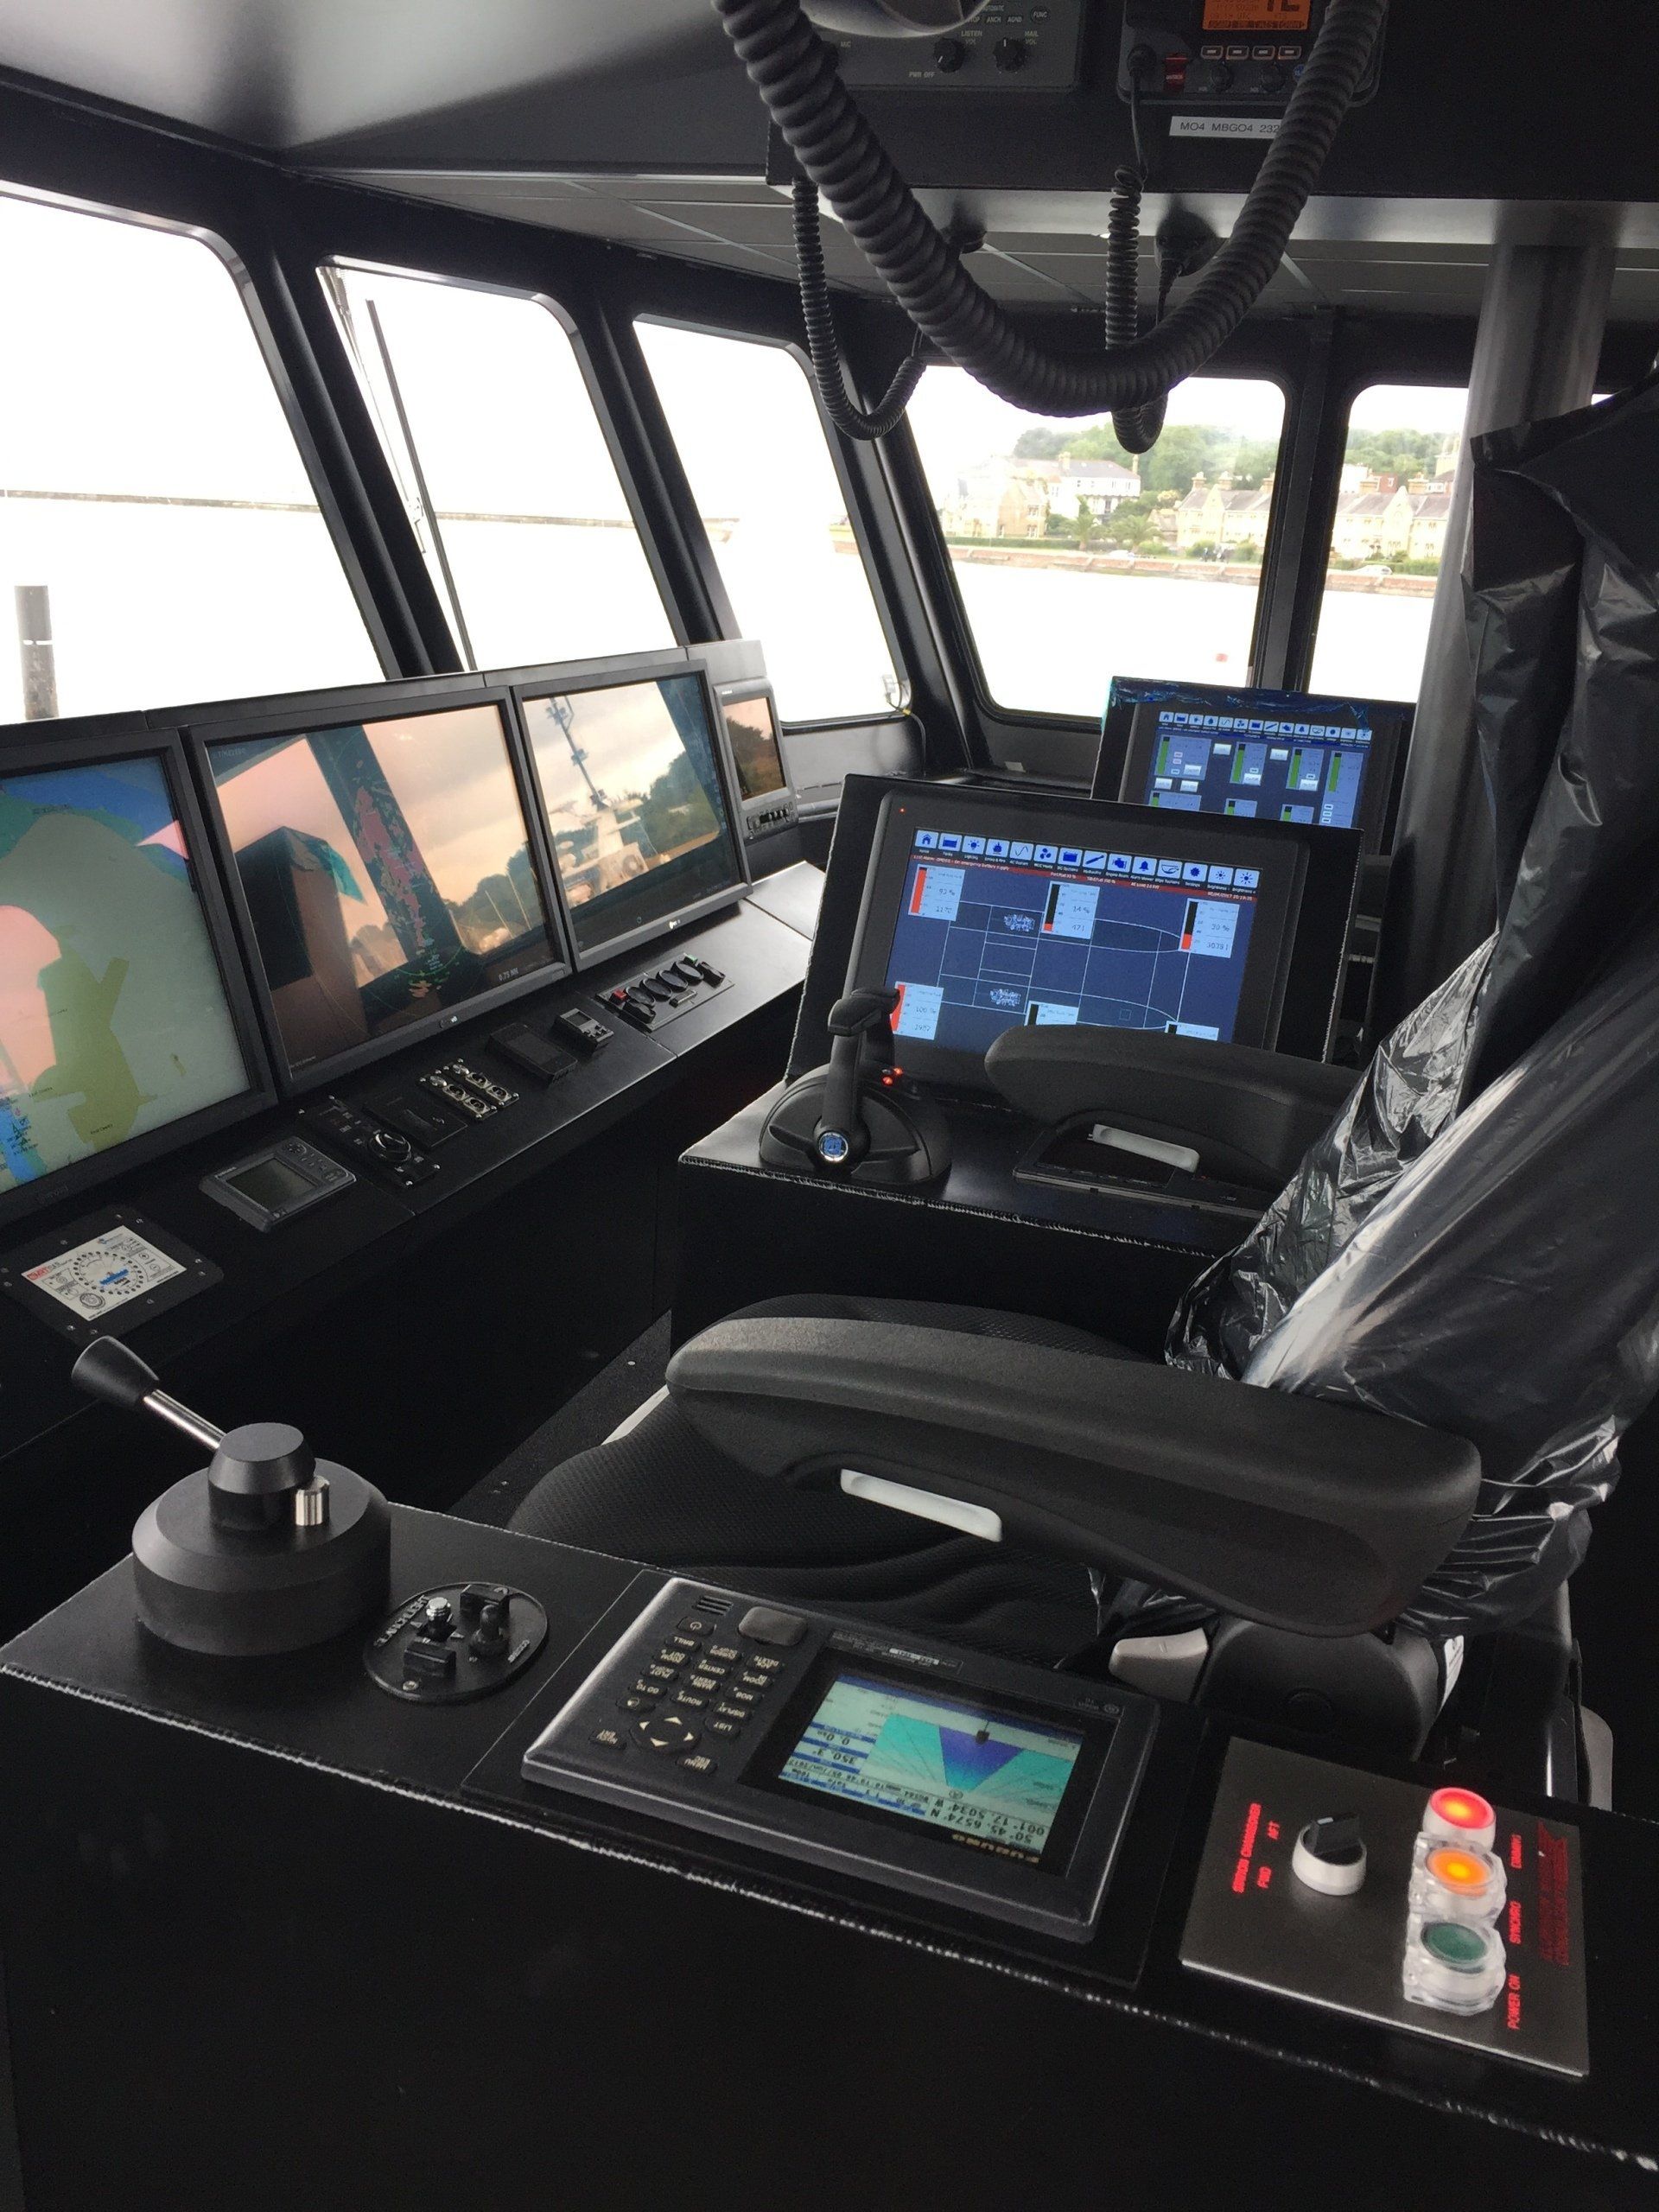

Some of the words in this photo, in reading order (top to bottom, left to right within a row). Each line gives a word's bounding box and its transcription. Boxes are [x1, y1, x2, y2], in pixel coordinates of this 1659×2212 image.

[675, 1694, 703, 1706] ROUTE
[734, 1691, 754, 1700] MOB
[716, 1705, 747, 1718] DISPLAY
[712, 1720, 733, 1732] LIST
[1266, 1819, 1280, 1840] AFT
[1509, 1899, 1521, 1945] SYNCHRO
[1508, 1973, 1520, 1992] ON
[1507, 1991, 1520, 2030] POWER
